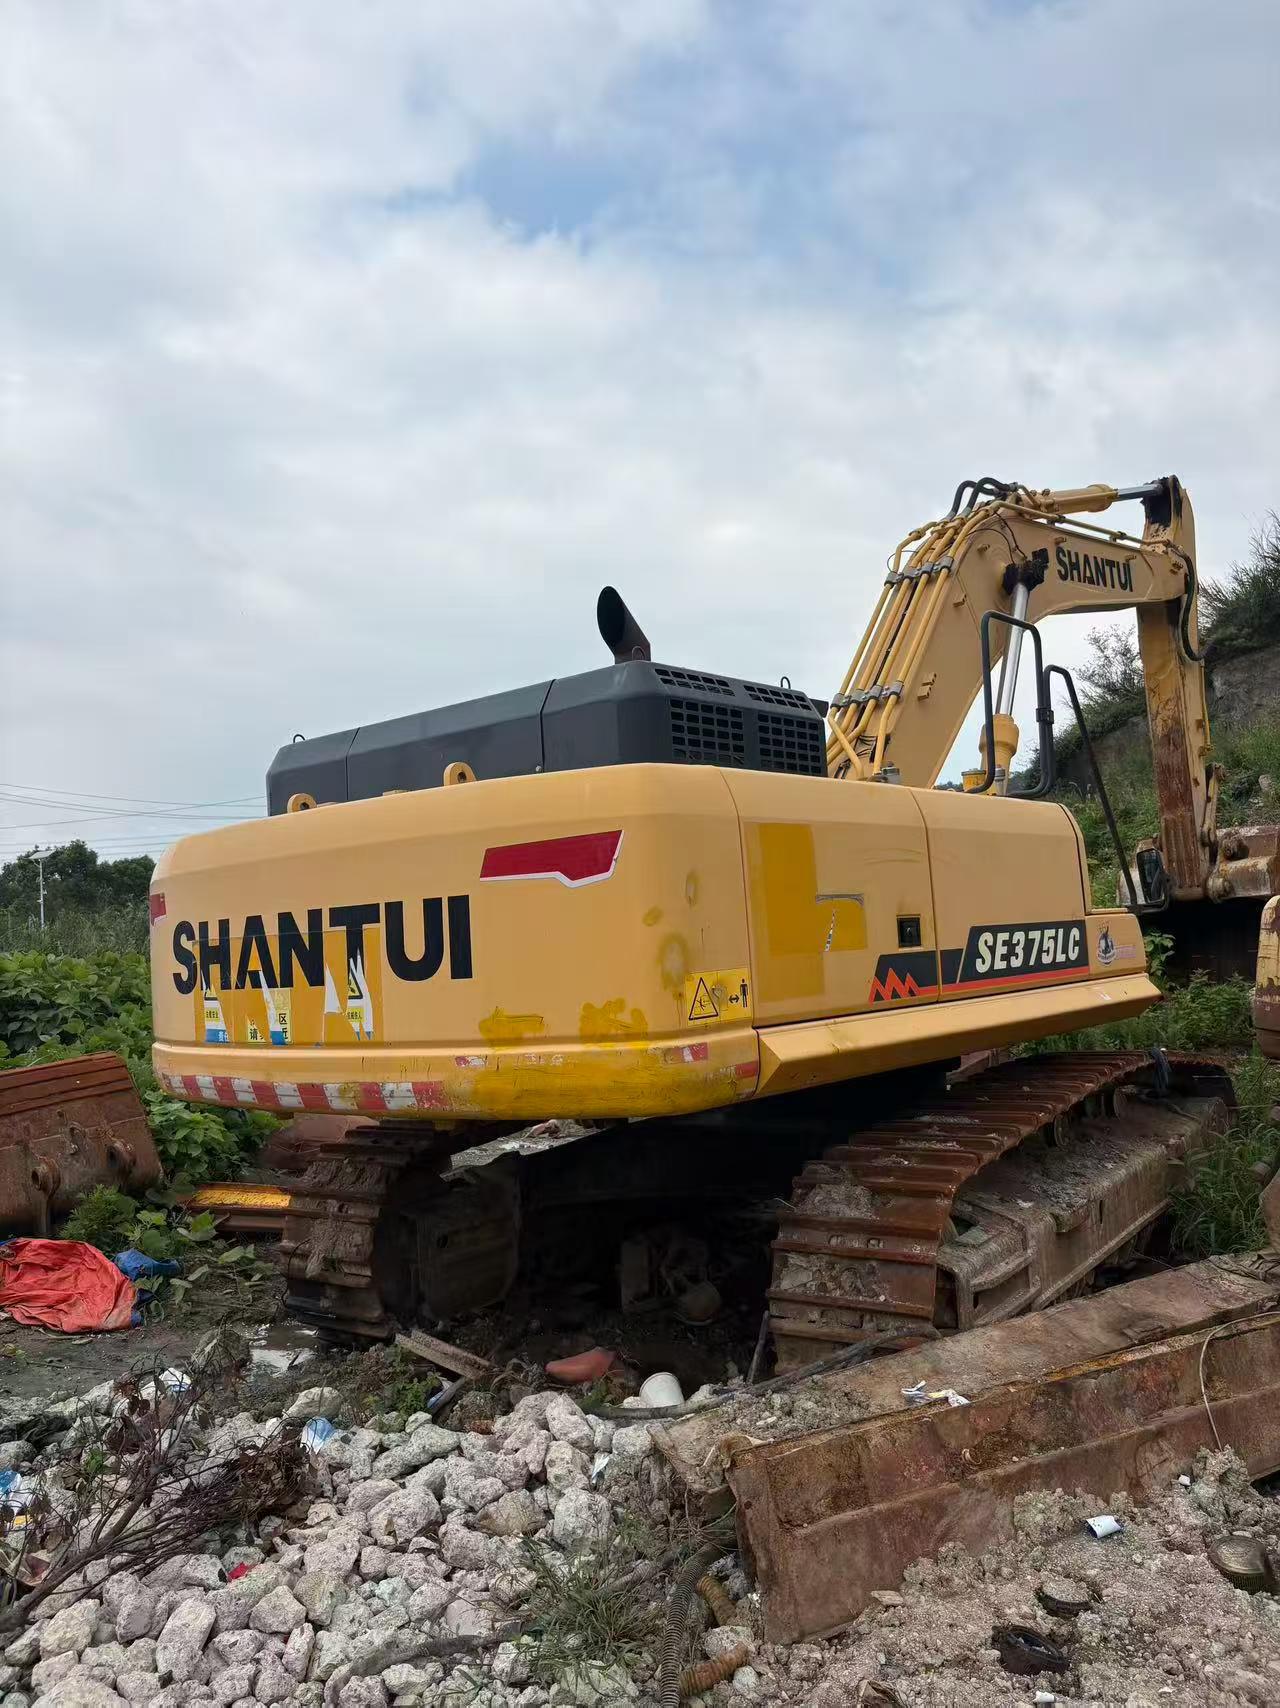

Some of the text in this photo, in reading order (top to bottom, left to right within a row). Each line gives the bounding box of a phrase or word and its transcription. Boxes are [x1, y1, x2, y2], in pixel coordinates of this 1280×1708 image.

[1055, 546, 1134, 593] SHANTUI
[172, 894, 473, 995] SHANTUI
[974, 926, 1081, 974] SE375LC
